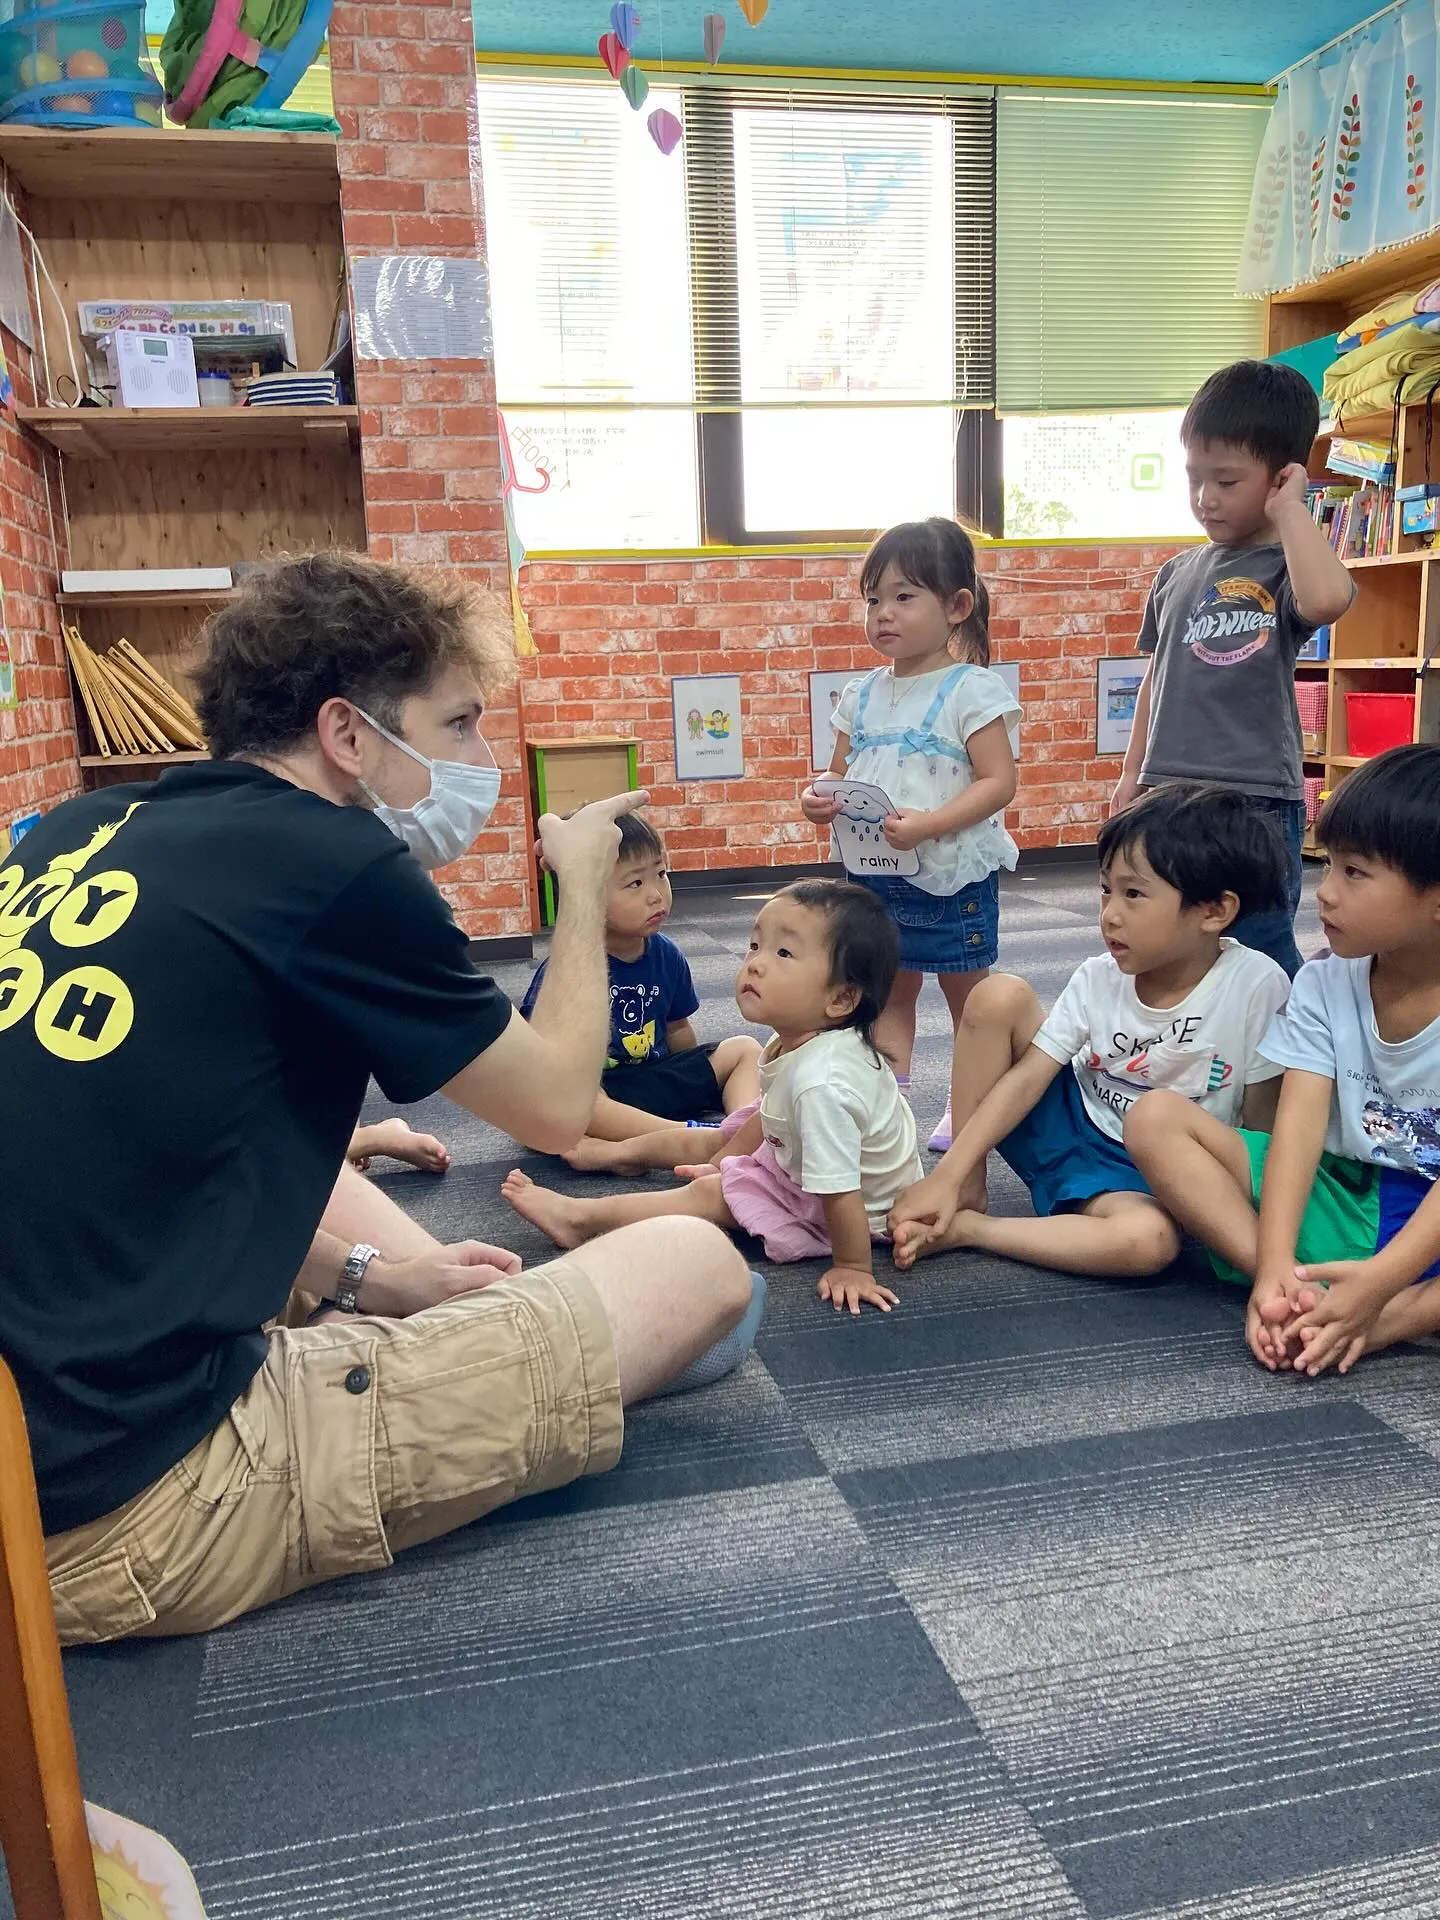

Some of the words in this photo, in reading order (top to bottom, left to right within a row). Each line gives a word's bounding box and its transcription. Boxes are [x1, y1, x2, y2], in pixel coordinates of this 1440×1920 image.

[160, 324, 176, 334] Cc
[178, 323, 196, 333] Dd
[199, 323, 215, 333] Ee
[859, 855, 899, 871] rainy
